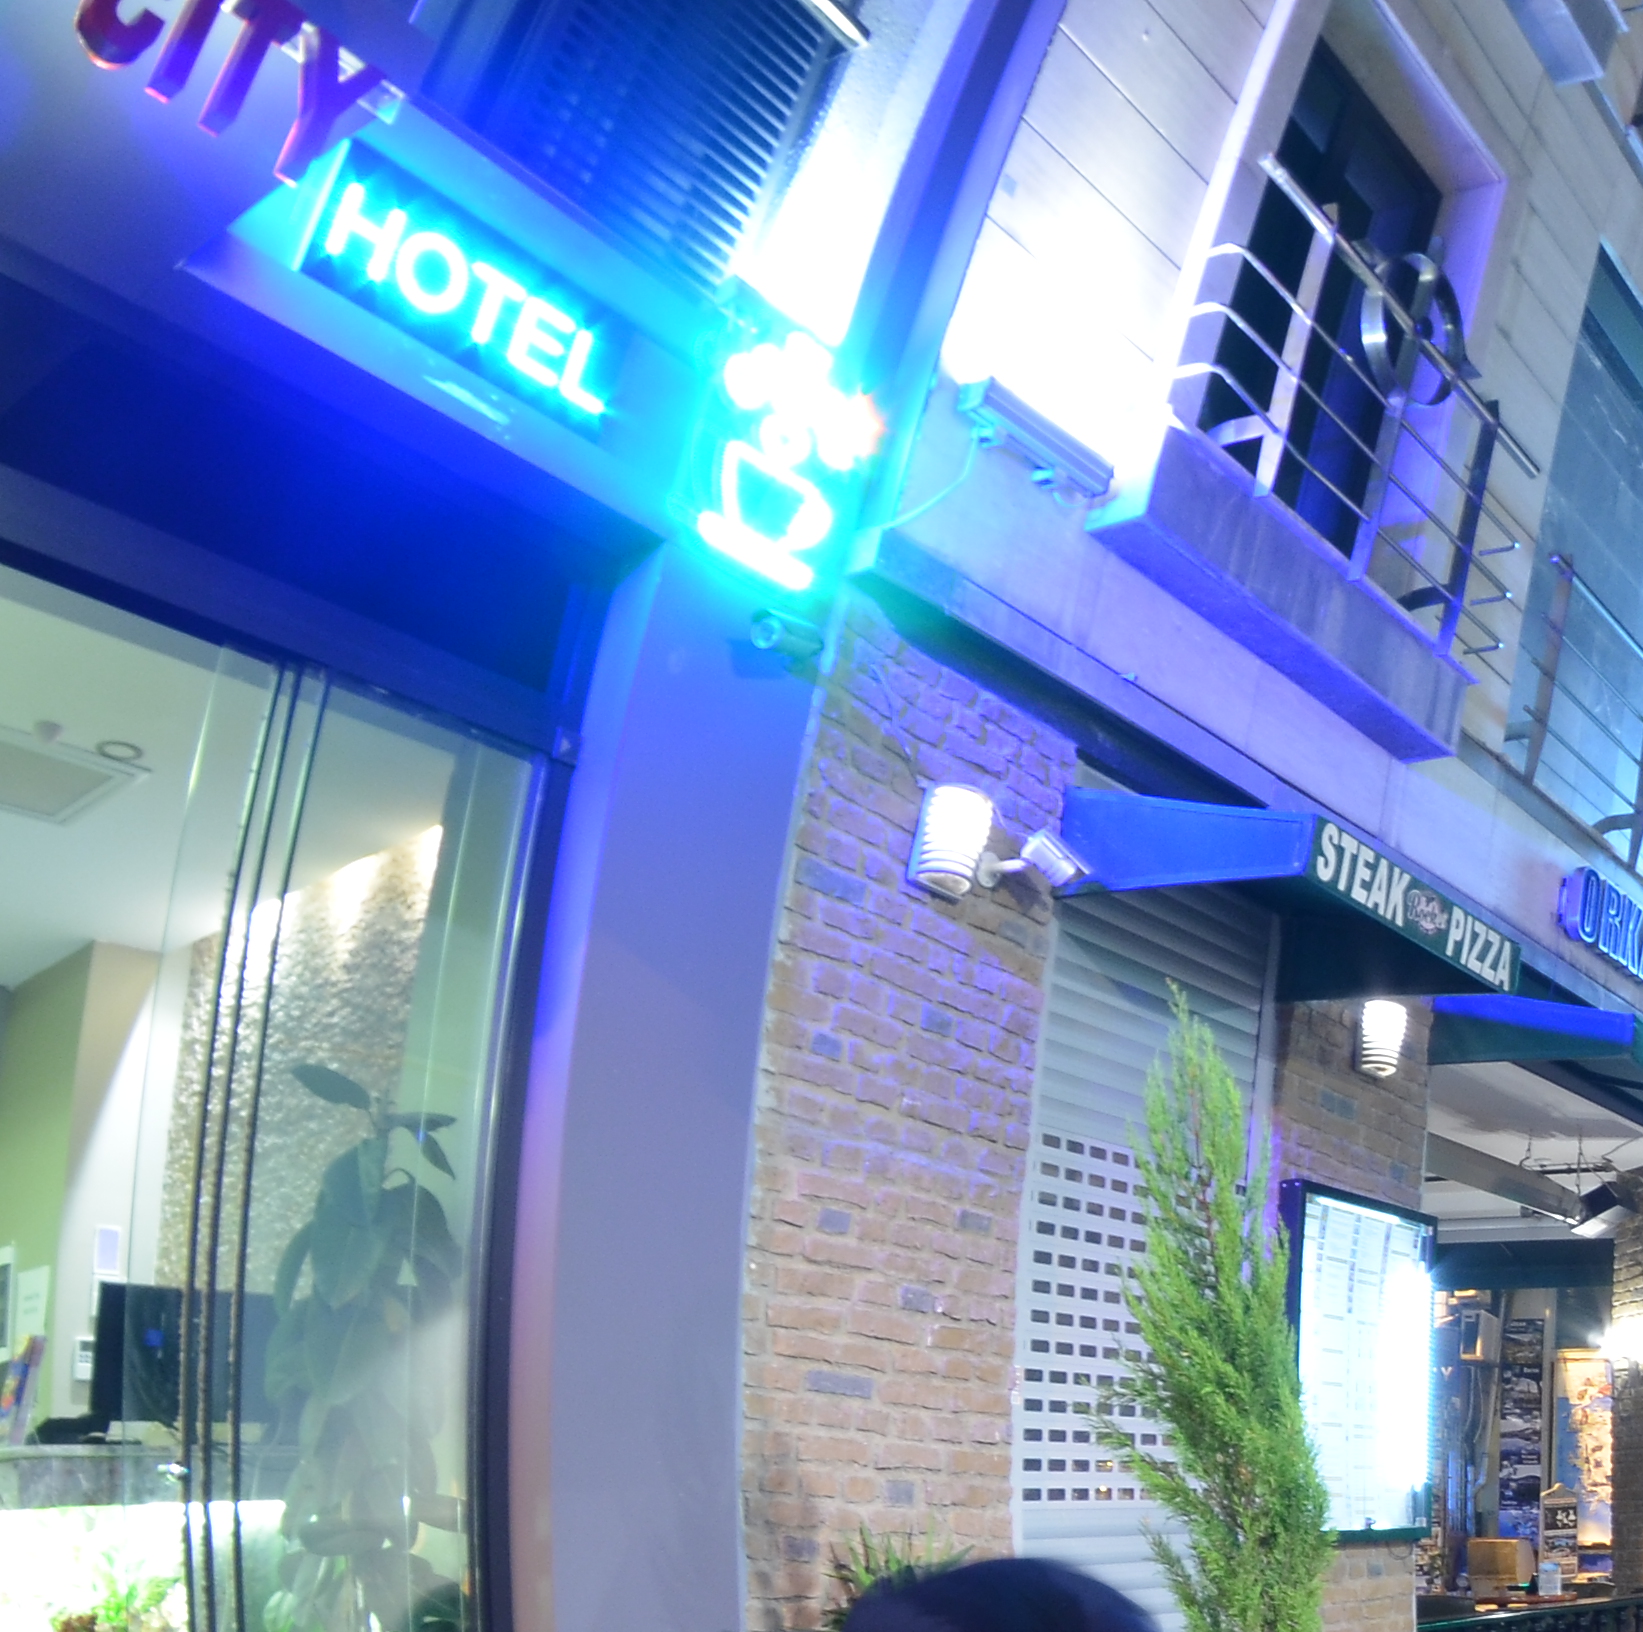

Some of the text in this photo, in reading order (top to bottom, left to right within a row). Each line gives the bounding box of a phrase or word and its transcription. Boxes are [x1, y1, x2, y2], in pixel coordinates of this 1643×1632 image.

[75, 0, 389, 189] CITY
[325, 182, 605, 416] HOTEL
[1316, 822, 1412, 928] STEAK
[1445, 905, 1512, 992] PIZZA
